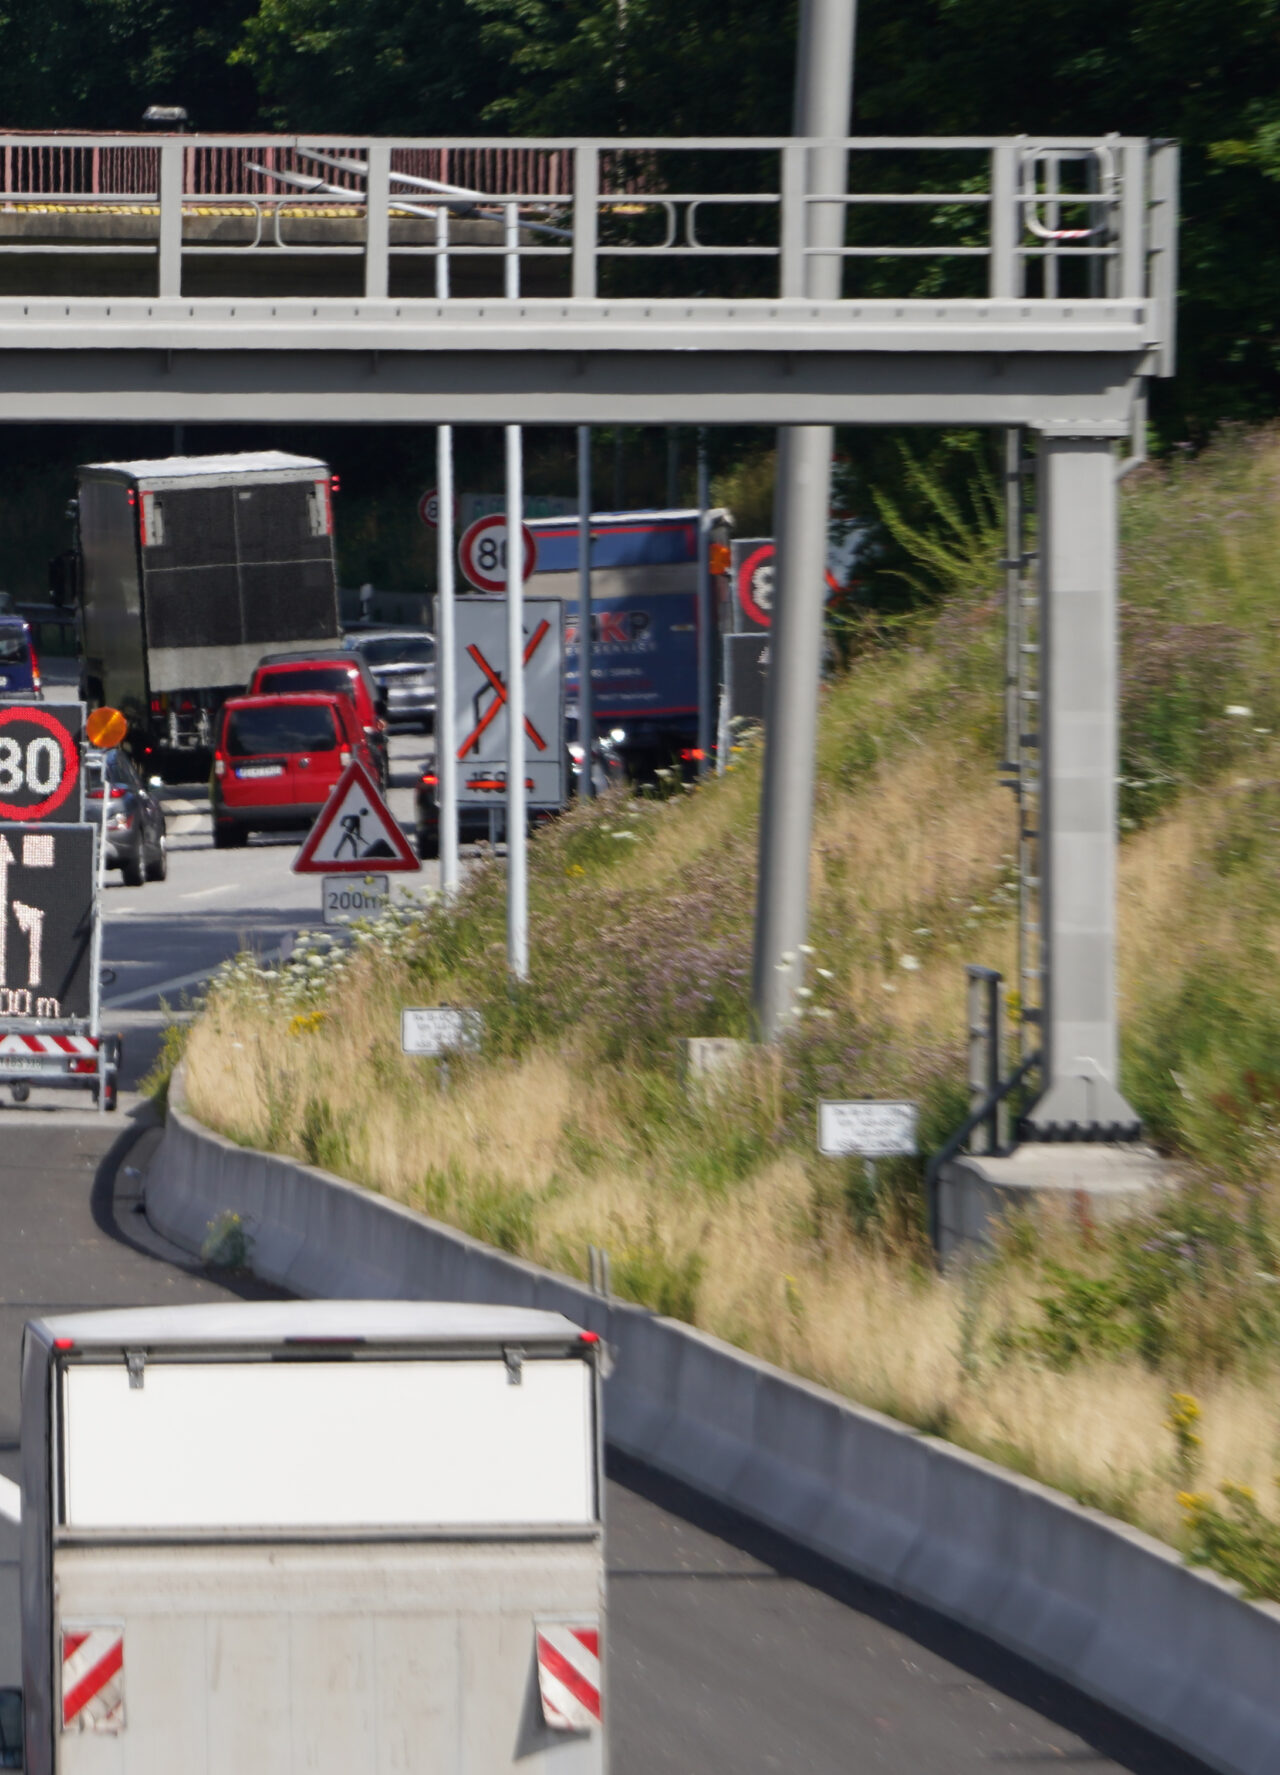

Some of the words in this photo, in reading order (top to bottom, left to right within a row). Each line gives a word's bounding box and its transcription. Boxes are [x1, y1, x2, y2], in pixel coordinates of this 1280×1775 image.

[752, 566, 776, 610] 8
[327, 891, 378, 909] 200m
[37, 997, 60, 1018] m
